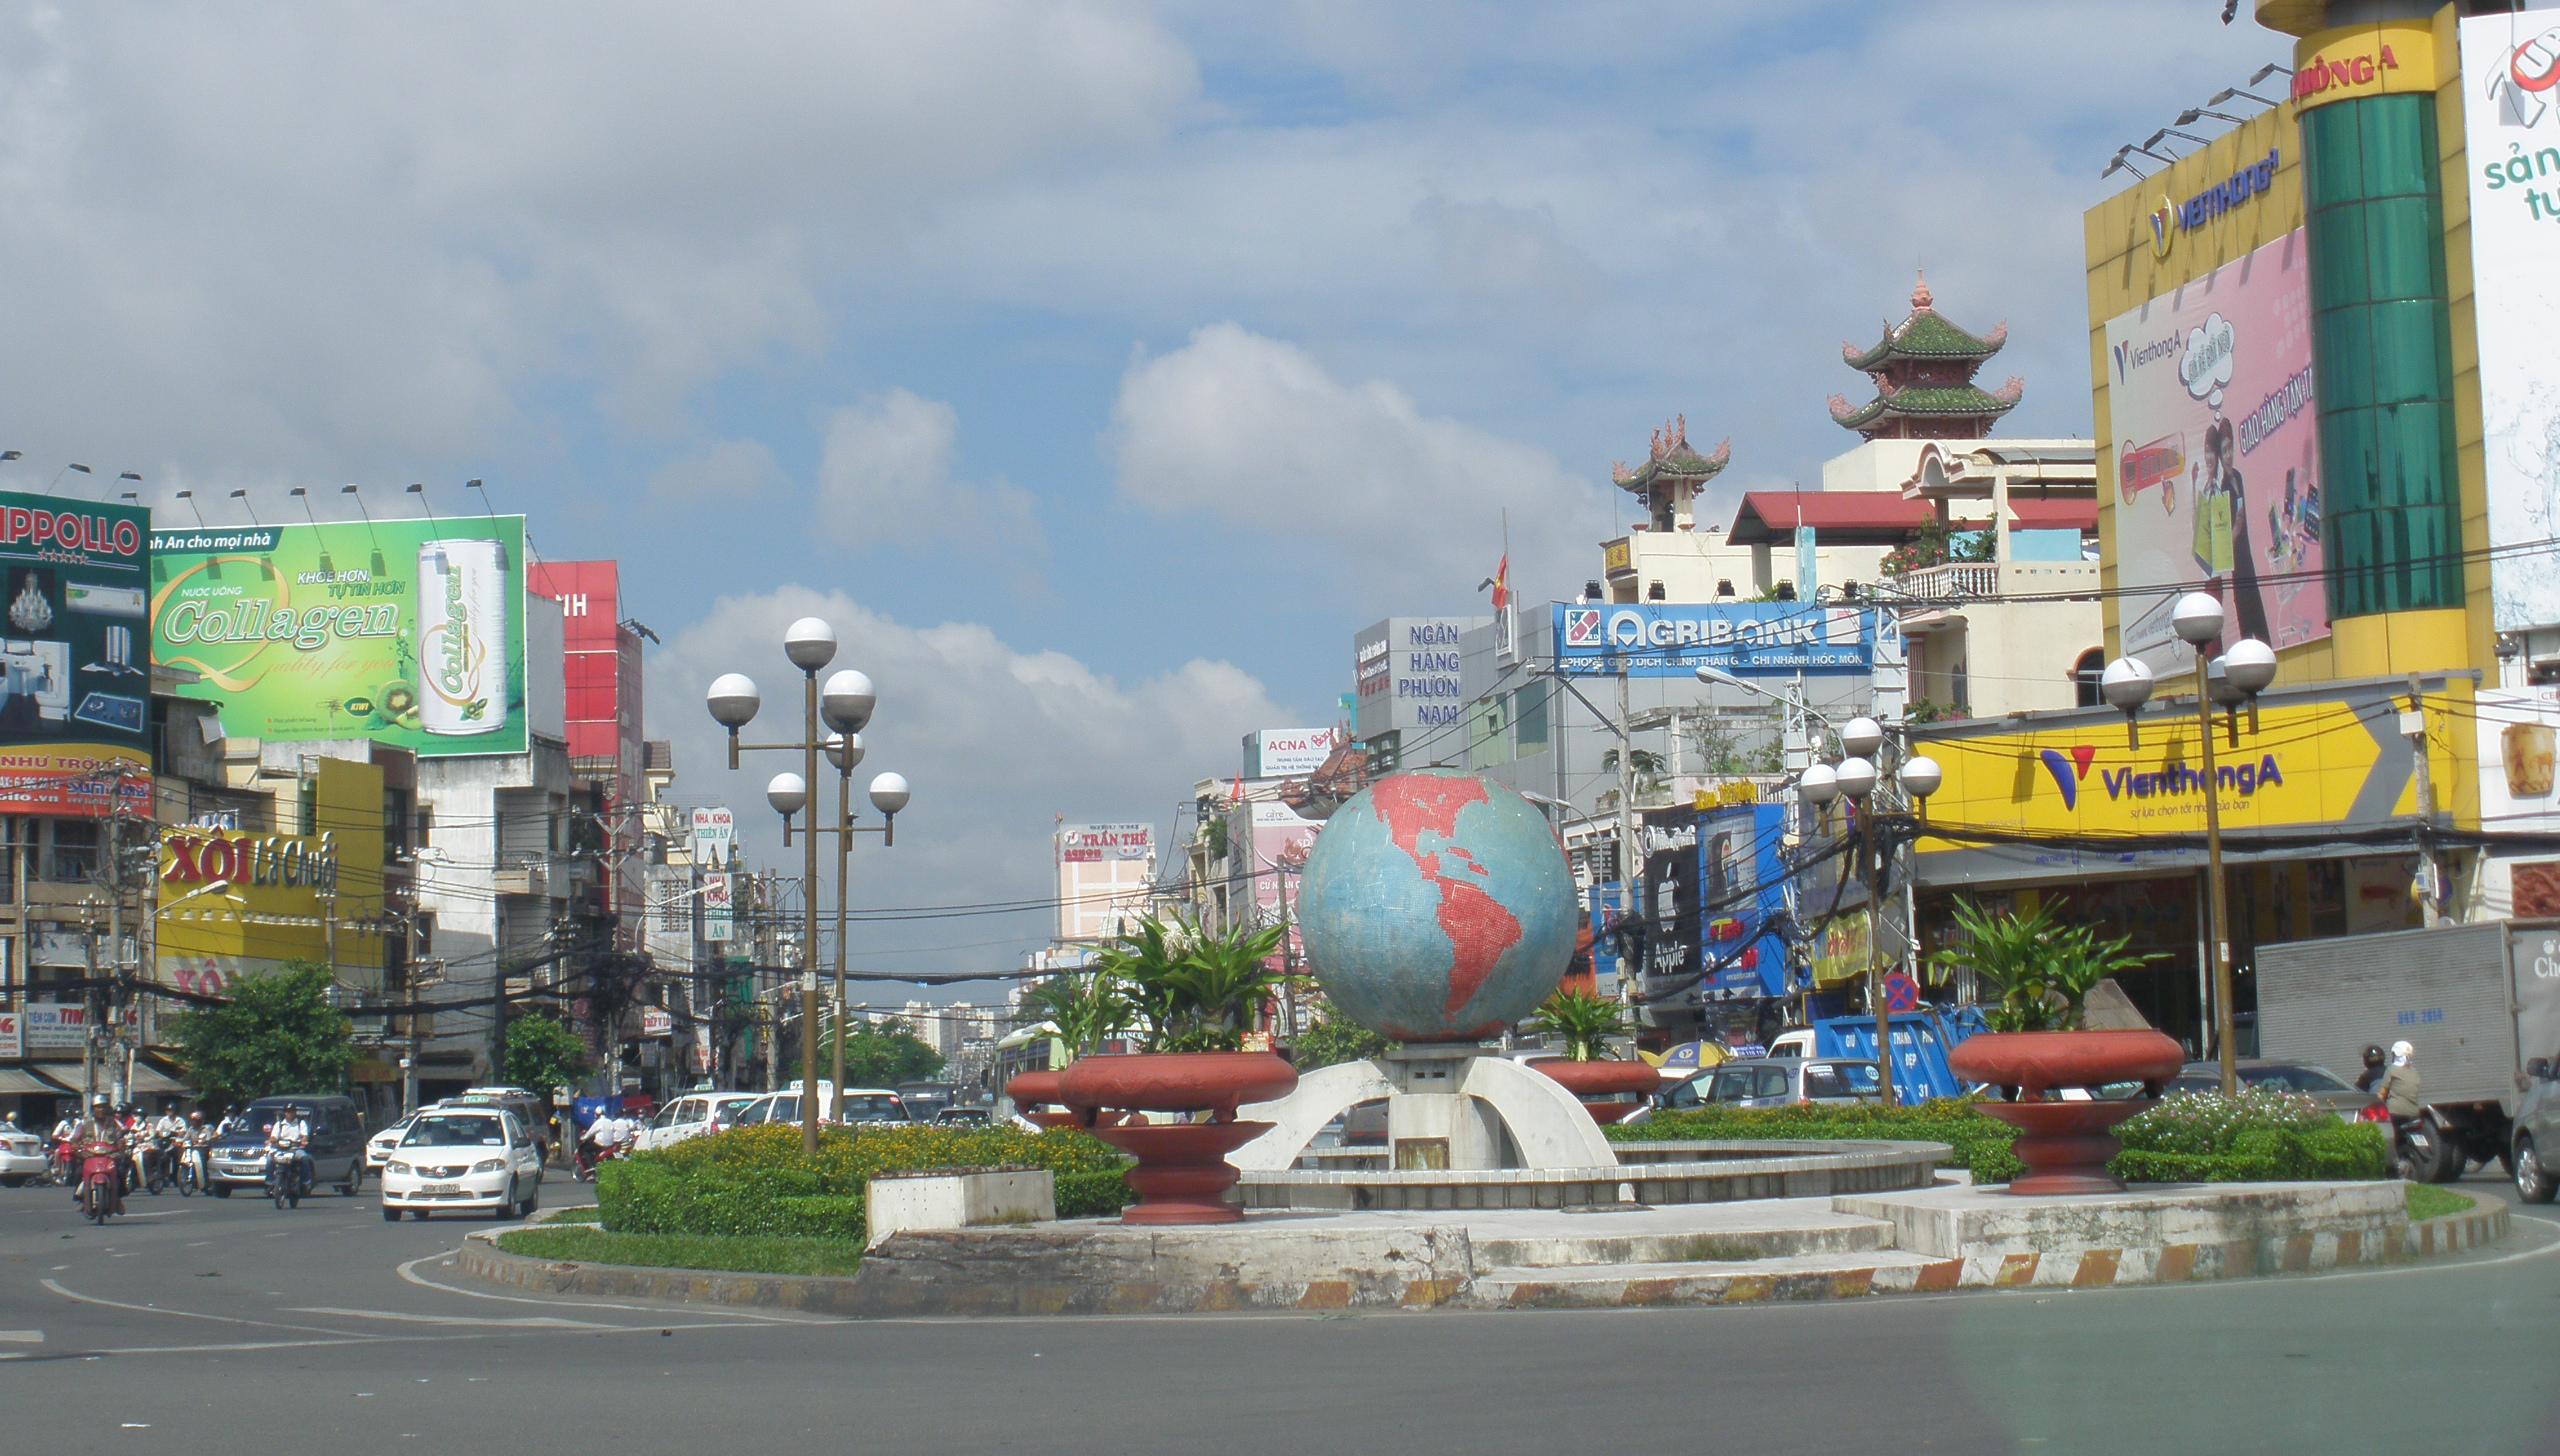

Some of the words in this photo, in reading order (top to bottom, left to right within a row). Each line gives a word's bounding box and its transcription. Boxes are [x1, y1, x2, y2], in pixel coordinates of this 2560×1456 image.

[2239, 413, 2260, 455] GIAO
[165, 536, 184, 549] An
[187, 535, 212, 548] cho
[214, 534, 242, 550] mọi
[243, 532, 271, 546] nhà
[162, 597, 399, 650] Collagen
[441, 565, 467, 694] Collagen
[1410, 622, 1458, 644] NGÂN
[1411, 648, 1459, 670] HÀNG
[1752, 656, 1770, 665] CHI
[1773, 653, 1810, 665] NHÁNH
[1813, 653, 1836, 665] HÓC
[1839, 653, 1863, 665] MÔN
[1419, 705, 1458, 723] NAM
[1268, 740, 1307, 750] ACNA
[695, 813, 709, 823] NHA
[712, 813, 731, 823] KHOA
[162, 823, 252, 884] XÔI
[253, 837, 279, 886] Lá
[1655, 941, 1689, 973] Apple
